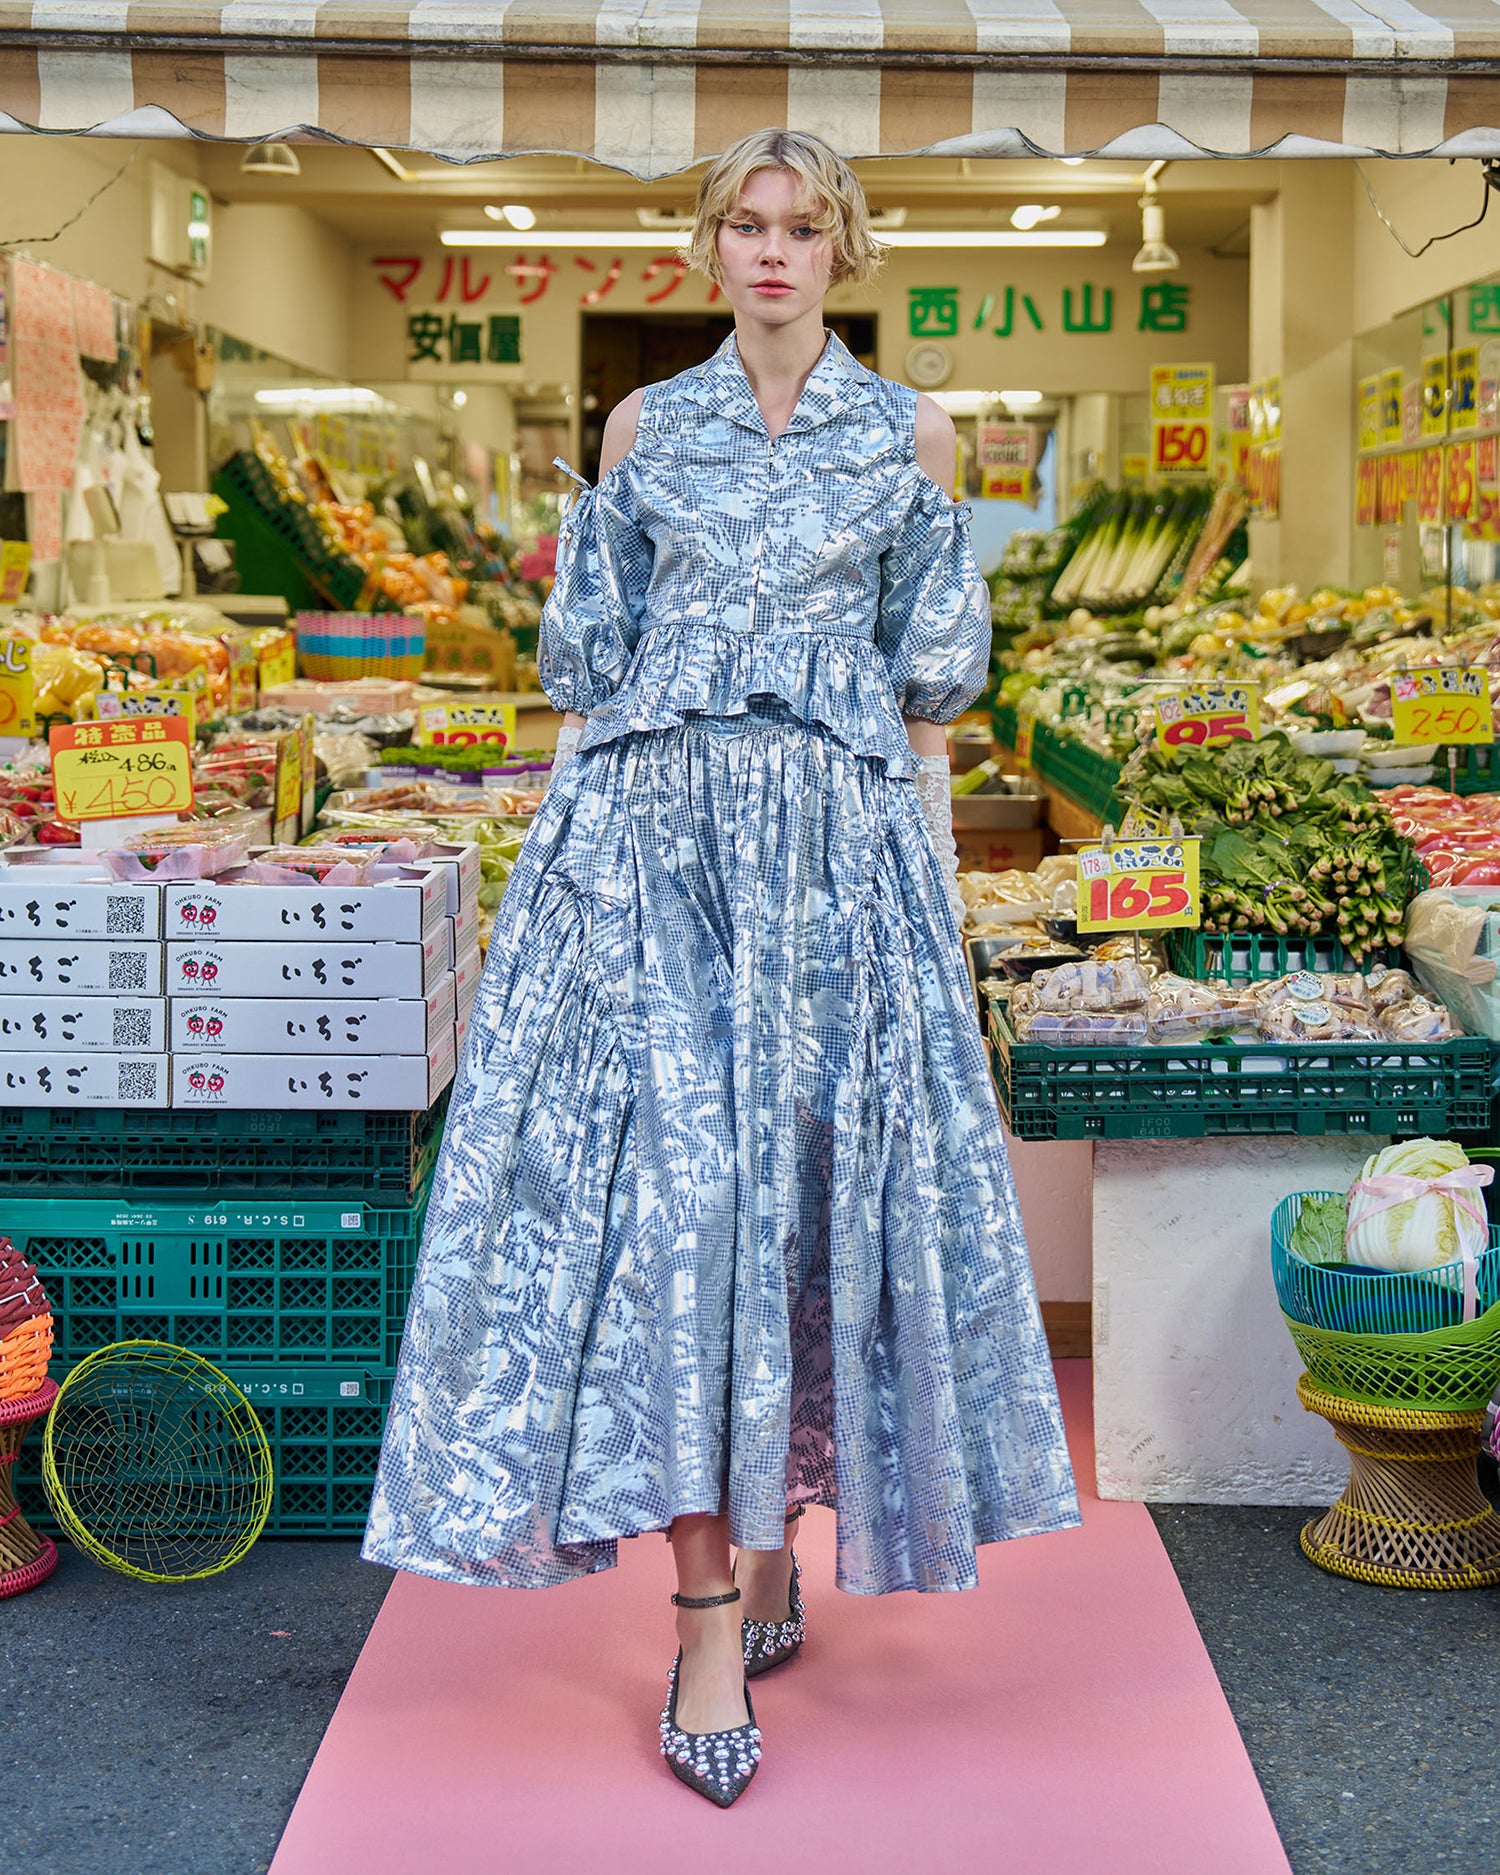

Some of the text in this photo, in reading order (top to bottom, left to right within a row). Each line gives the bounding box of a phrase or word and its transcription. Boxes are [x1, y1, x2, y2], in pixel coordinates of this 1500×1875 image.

[907, 281, 1190, 337] 西小山店
[1159, 426, 1206, 462] 150
[73, 721, 166, 746] 特売品
[174, 894, 222, 907] OHKUBO FARM
[281, 902, 362, 931] いちご
[175, 949, 223, 963] OHKUBO FARM
[282, 957, 363, 986] いちご
[181, 1005, 228, 1018] OHKUBO FARM
[2, 1012, 83, 1040] いちご
[286, 1014, 367, 1042] いちご
[6, 1066, 88, 1094] いちご
[182, 1062, 230, 1076] OHKUBO FARM
[288, 1070, 369, 1098] いちご
[204, 1215, 227, 1225] 619
